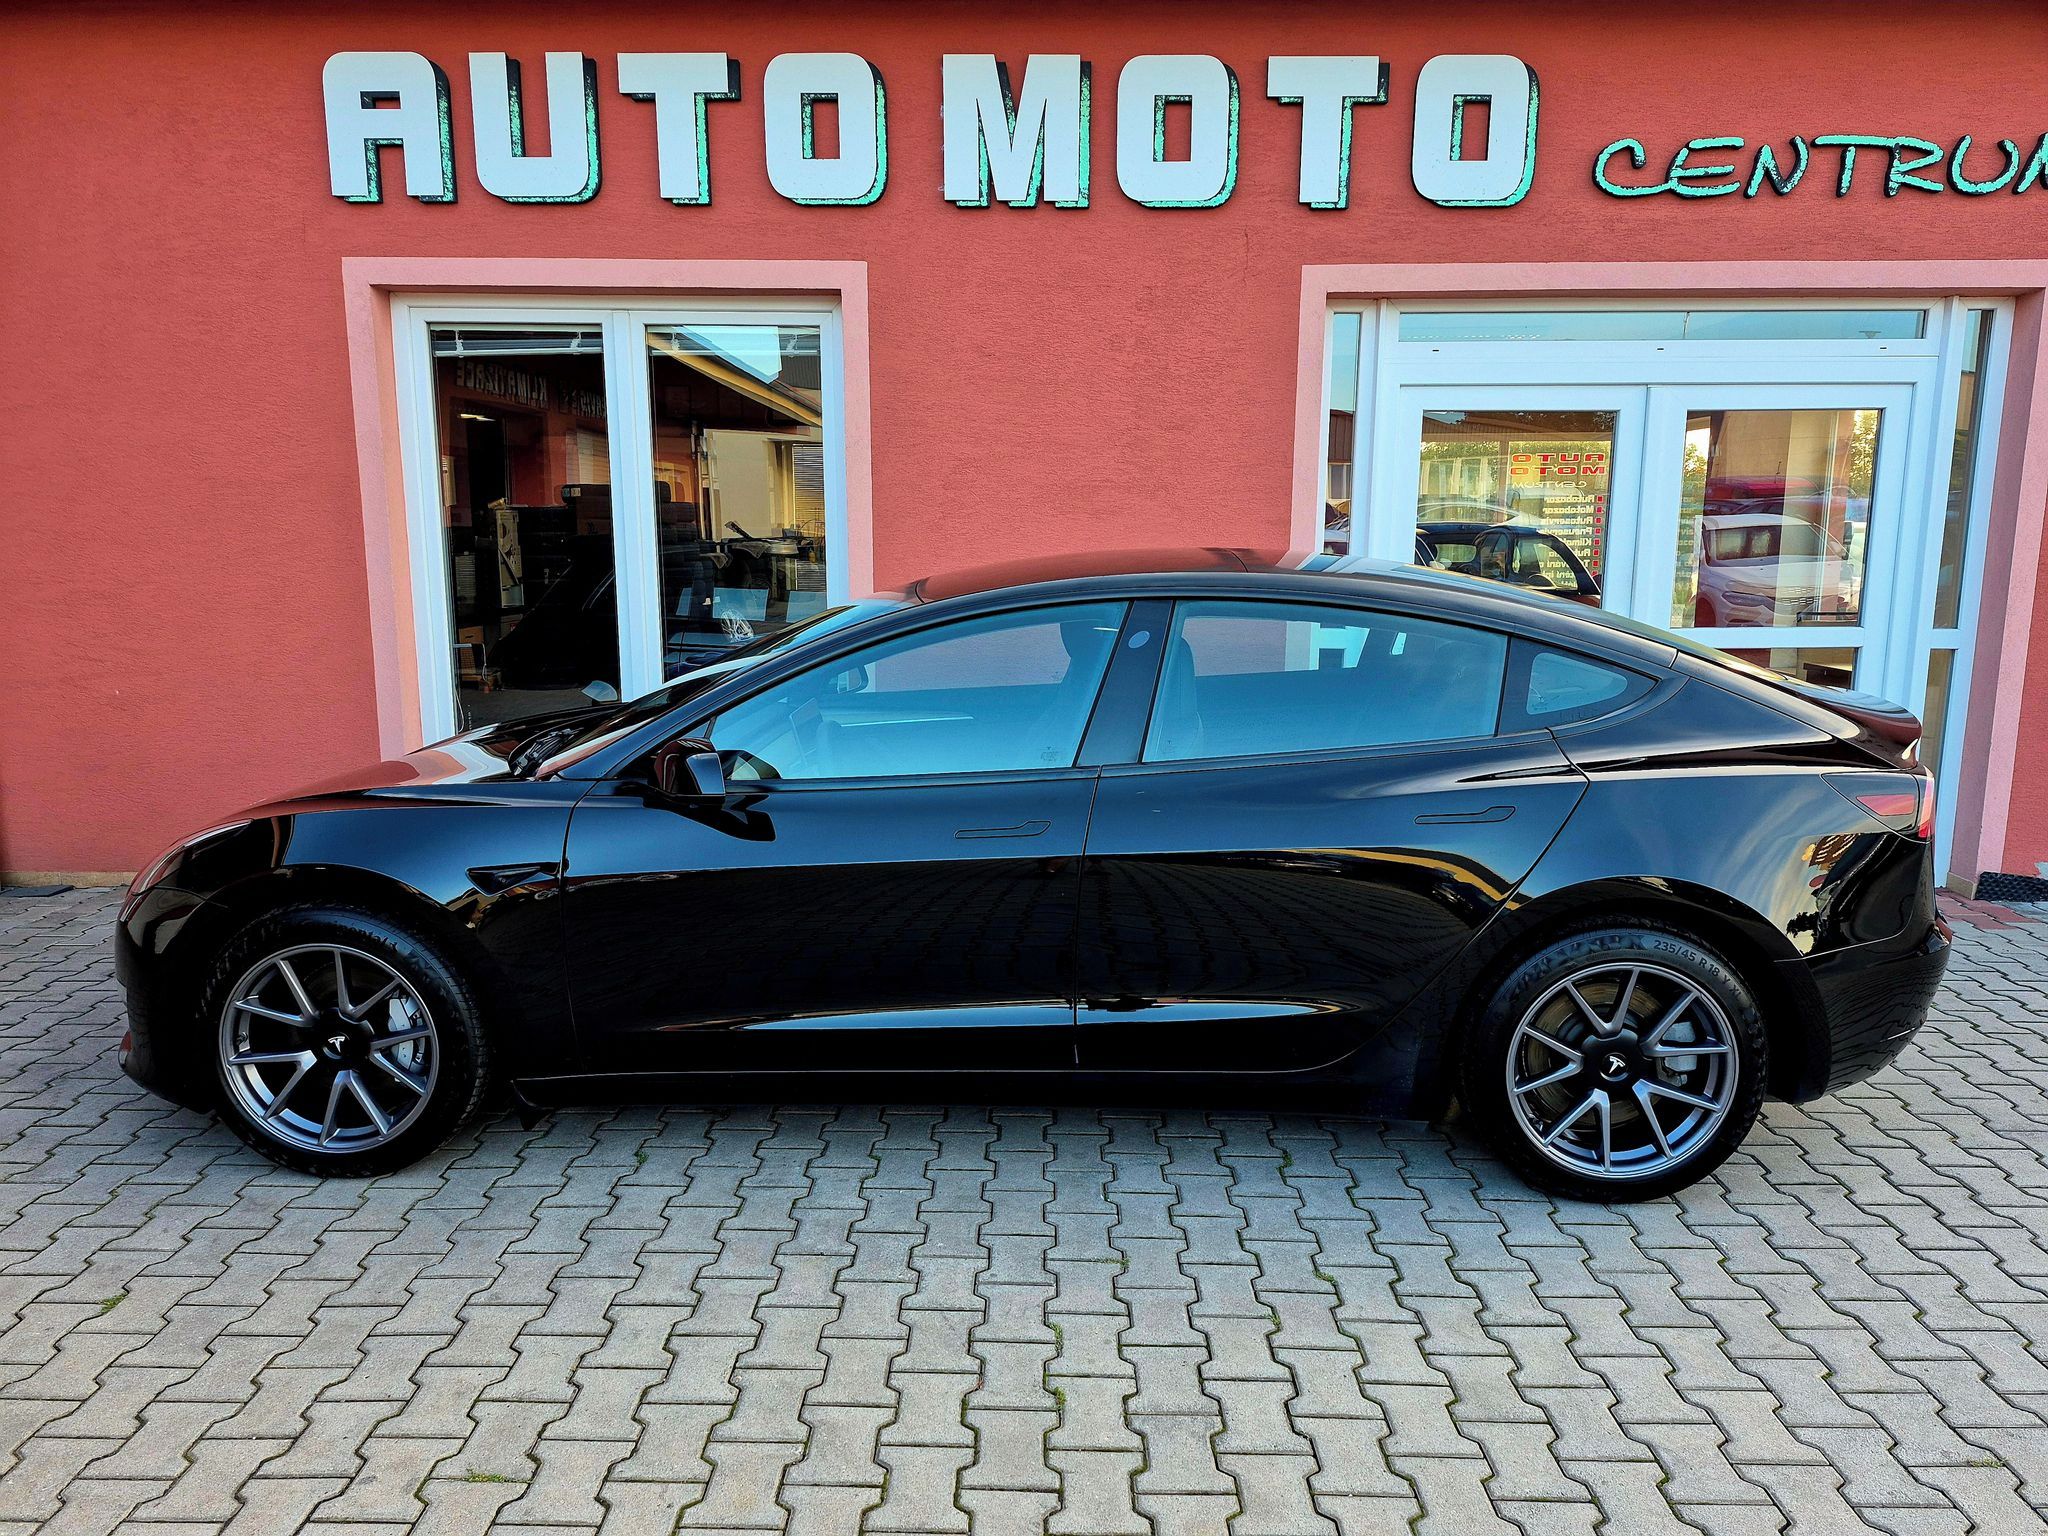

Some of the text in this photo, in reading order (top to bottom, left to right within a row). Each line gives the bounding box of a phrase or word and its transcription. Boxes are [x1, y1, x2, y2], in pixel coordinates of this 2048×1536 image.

[322, 51, 888, 205] AUTO
[942, 53, 1540, 209] MOTO
[1653, 940, 1697, 962] 235/45
